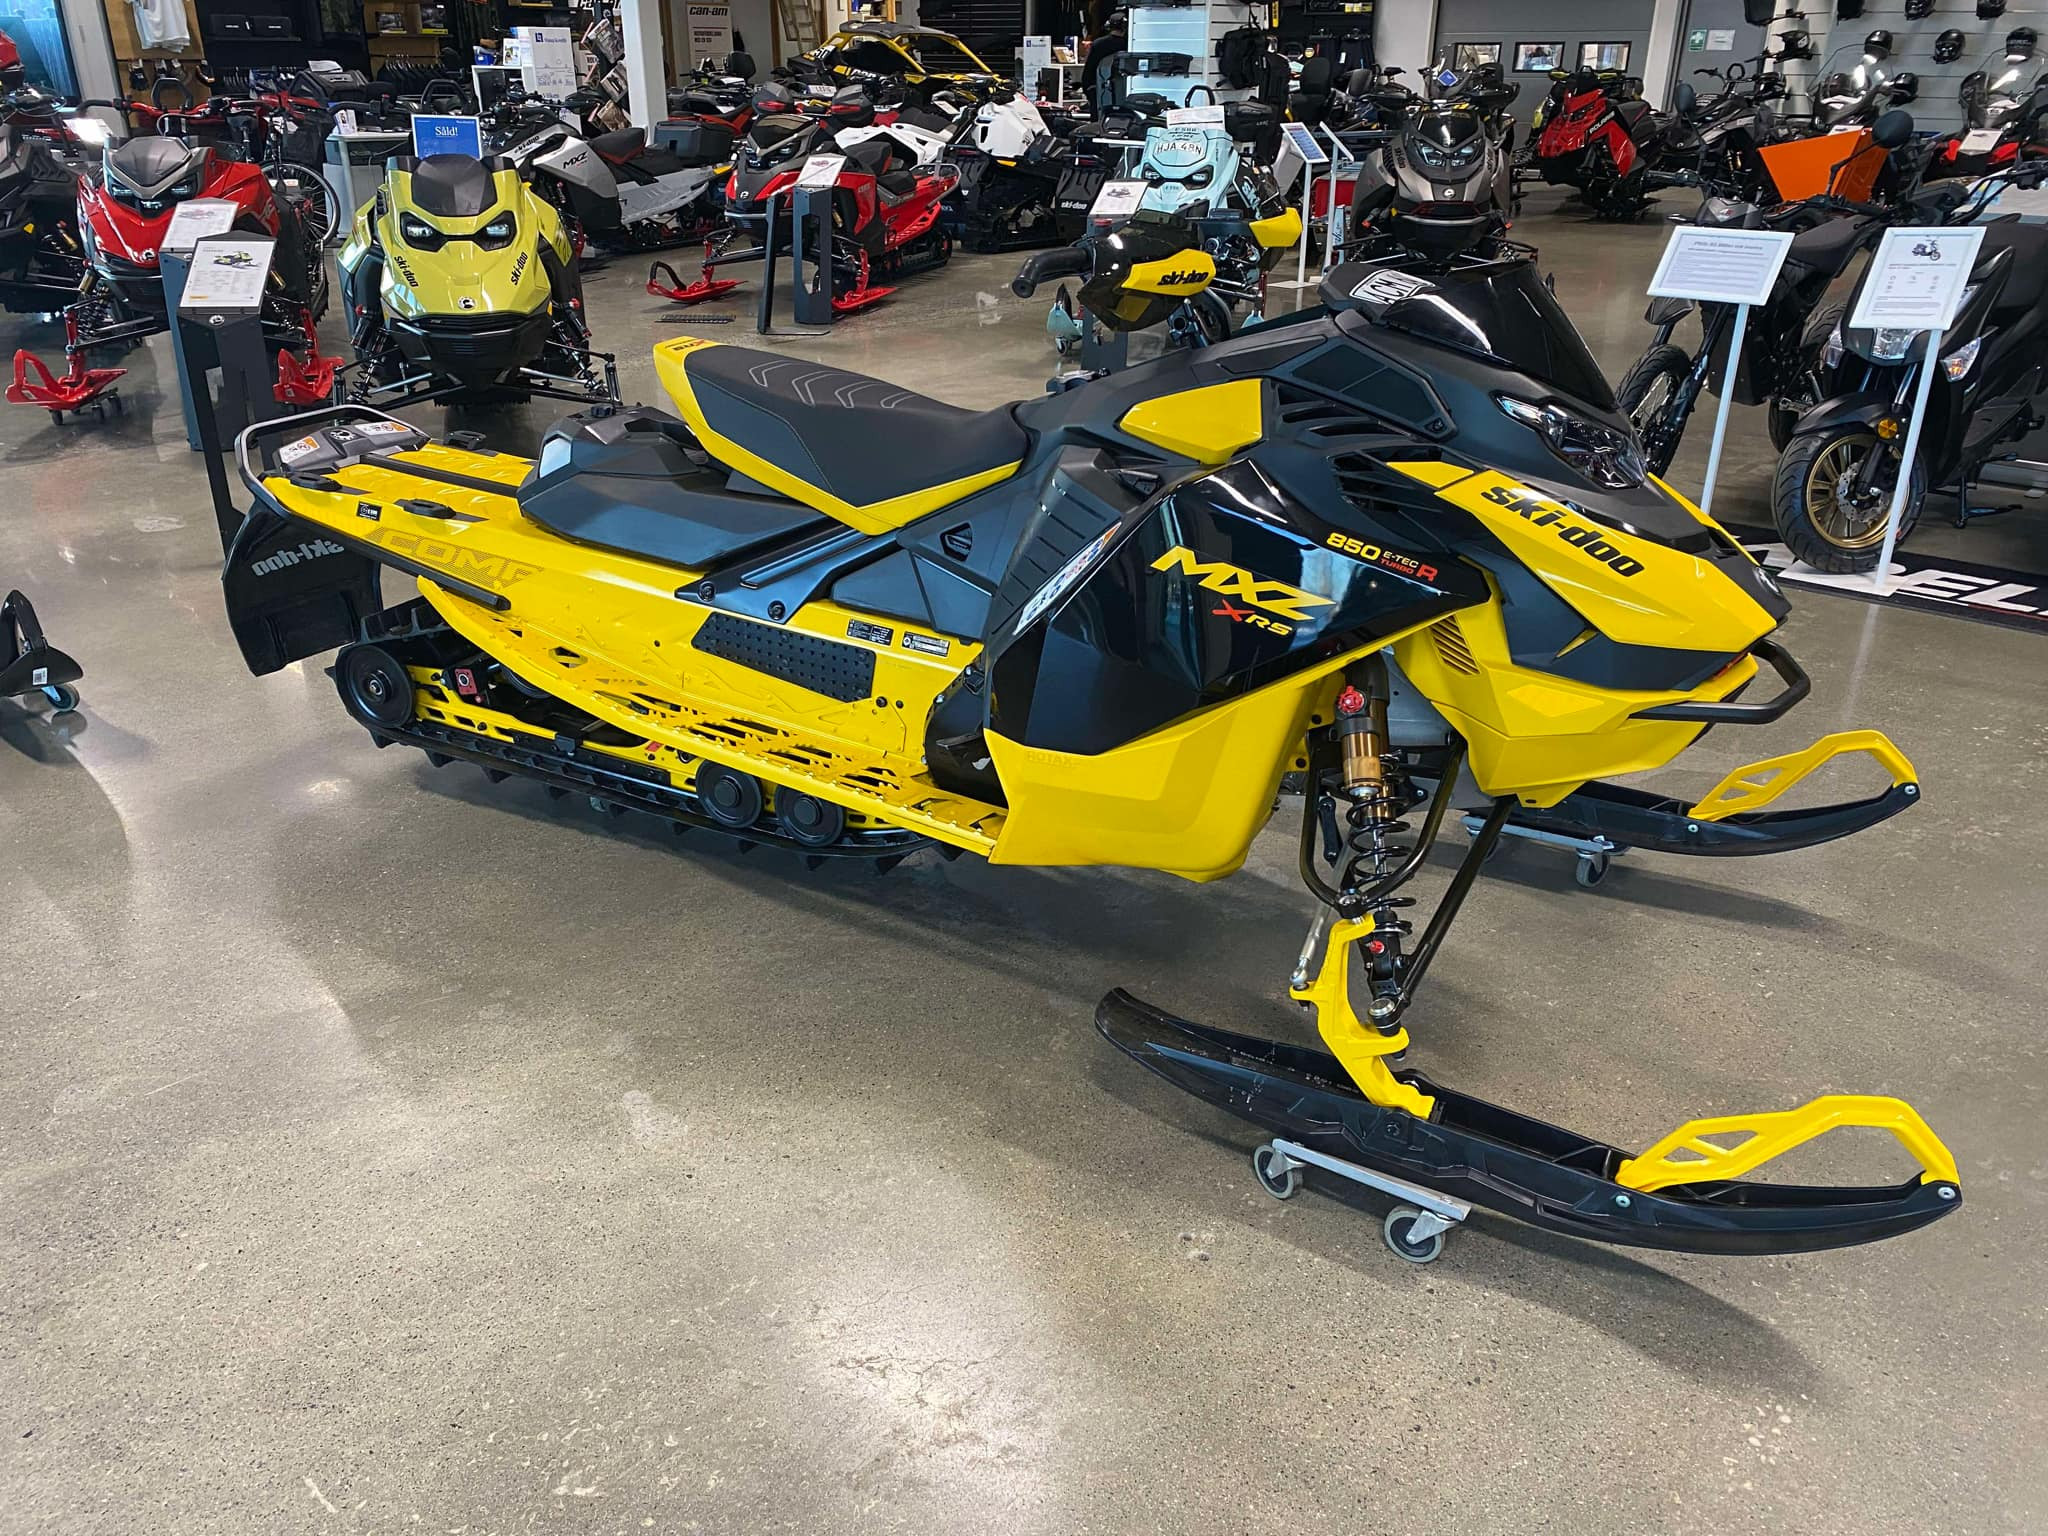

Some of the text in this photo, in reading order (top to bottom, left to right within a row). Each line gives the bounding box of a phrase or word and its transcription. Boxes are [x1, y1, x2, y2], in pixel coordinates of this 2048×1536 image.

[689, 6, 729, 17] can-am
[434, 126, 459, 138] Såld!
[562, 151, 588, 170] MXZ
[1061, 200, 1088, 210] ski-doo
[394, 255, 419, 288] ski-doo
[511, 251, 529, 286] ski-doo
[1156, 269, 1210, 286] ski-doo
[1480, 486, 1645, 578] ski-doo
[1326, 531, 1420, 569] 850 E-TEC
[1150, 545, 1338, 621] MXZ
[1380, 557, 1439, 583] TURBO R
